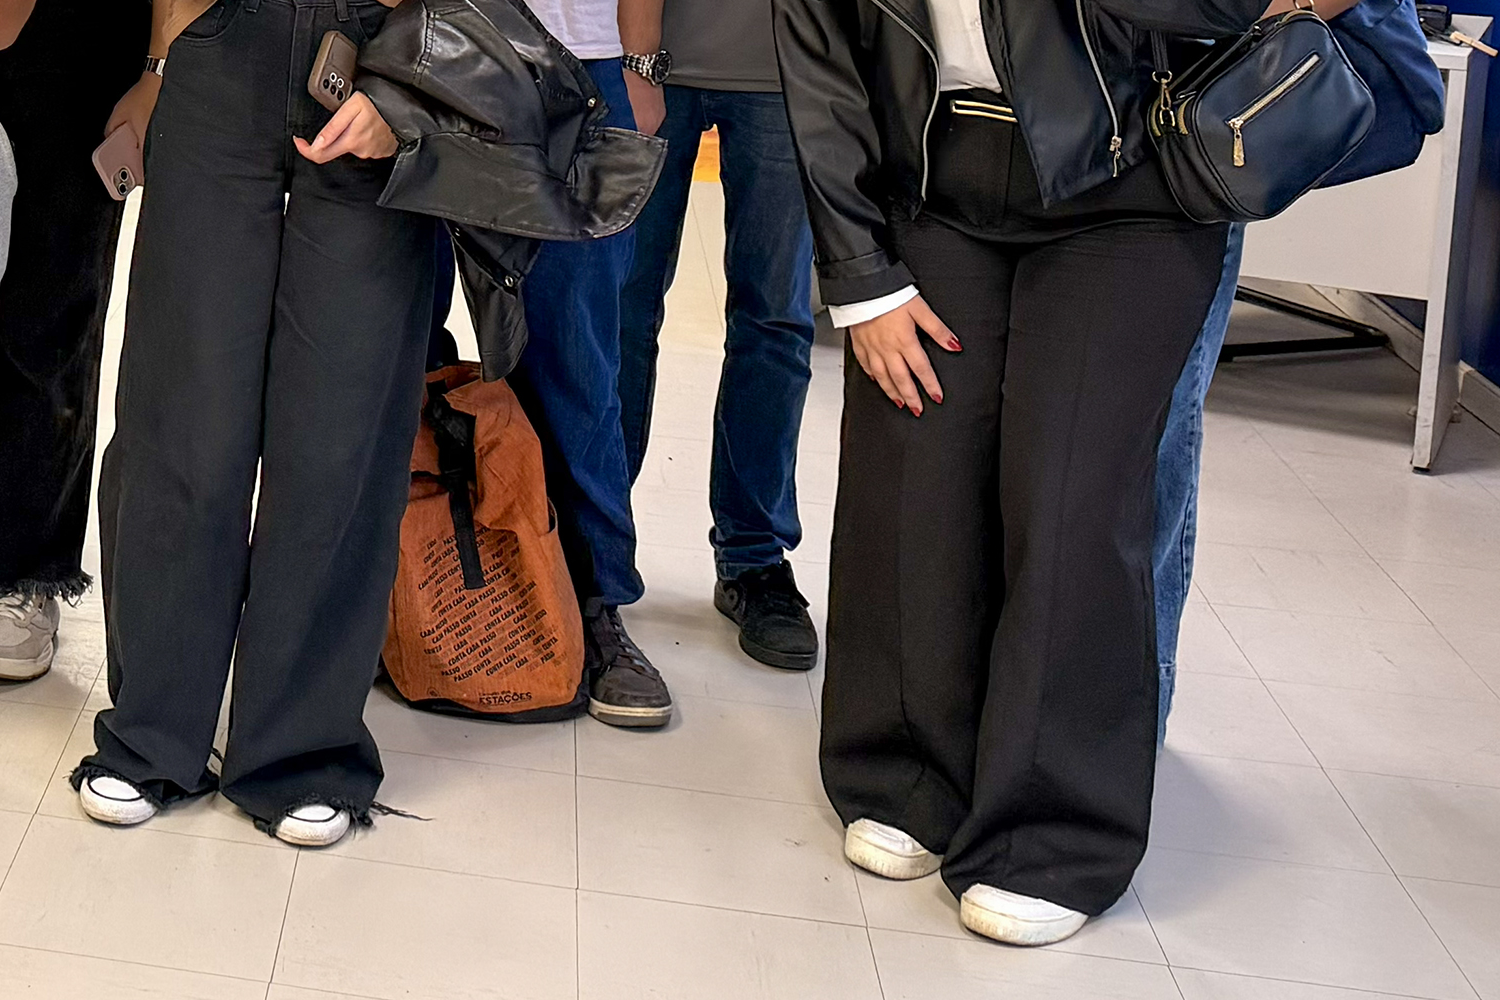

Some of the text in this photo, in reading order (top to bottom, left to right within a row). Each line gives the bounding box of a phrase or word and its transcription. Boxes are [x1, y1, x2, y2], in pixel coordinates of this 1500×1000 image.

[420, 628, 435, 638] CADA
[465, 598, 479, 610] CADA
[479, 587, 496, 601] PASSO
[443, 621, 460, 636] PASSO
[460, 610, 477, 624] CONTA
[491, 590, 508, 604] PASSO
[453, 594, 466, 607] CADA
[455, 625, 472, 639] PASSO
[489, 605, 503, 617] CADA
[441, 666, 460, 676] PASSO
[479, 646, 492, 658] CADA
[508, 624, 526, 639] CONTA
[448, 612, 528, 666] CONTA CADA PASSO CADA
[454, 639, 468, 651] CADA
[484, 617, 501, 631] CONTA
[501, 608, 516, 620] CADA
[454, 669, 473, 682] PASSO
[473, 658, 492, 673] CONTA
[504, 639, 520, 653] PASSO
[486, 661, 503, 676] CONTA
[503, 653, 517, 665] CADA
[515, 656, 529, 668] CADA
[479, 692, 532, 705] ESTAÇÕES
